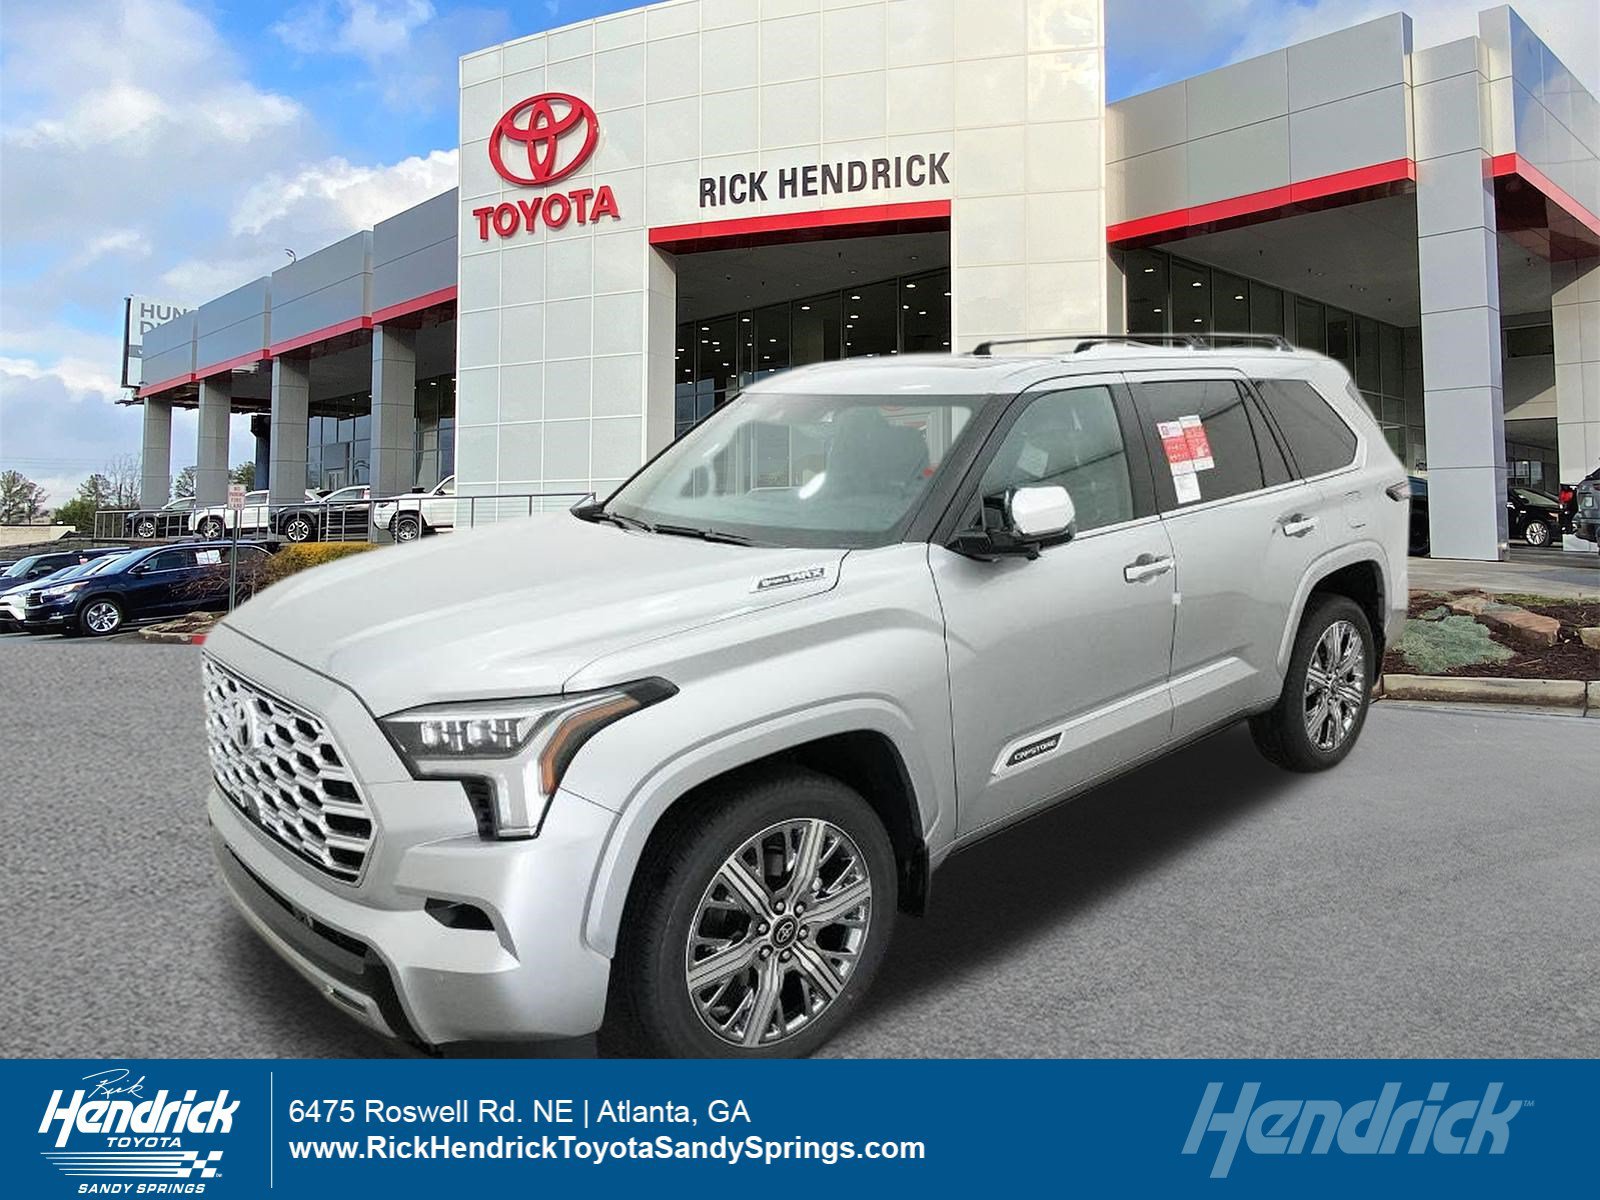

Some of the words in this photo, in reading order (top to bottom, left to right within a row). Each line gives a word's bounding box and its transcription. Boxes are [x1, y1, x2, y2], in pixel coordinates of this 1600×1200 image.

[699, 170, 768, 208] RICK
[779, 152, 950, 199] HENDRICK
[473, 185, 620, 240] TOYOTA
